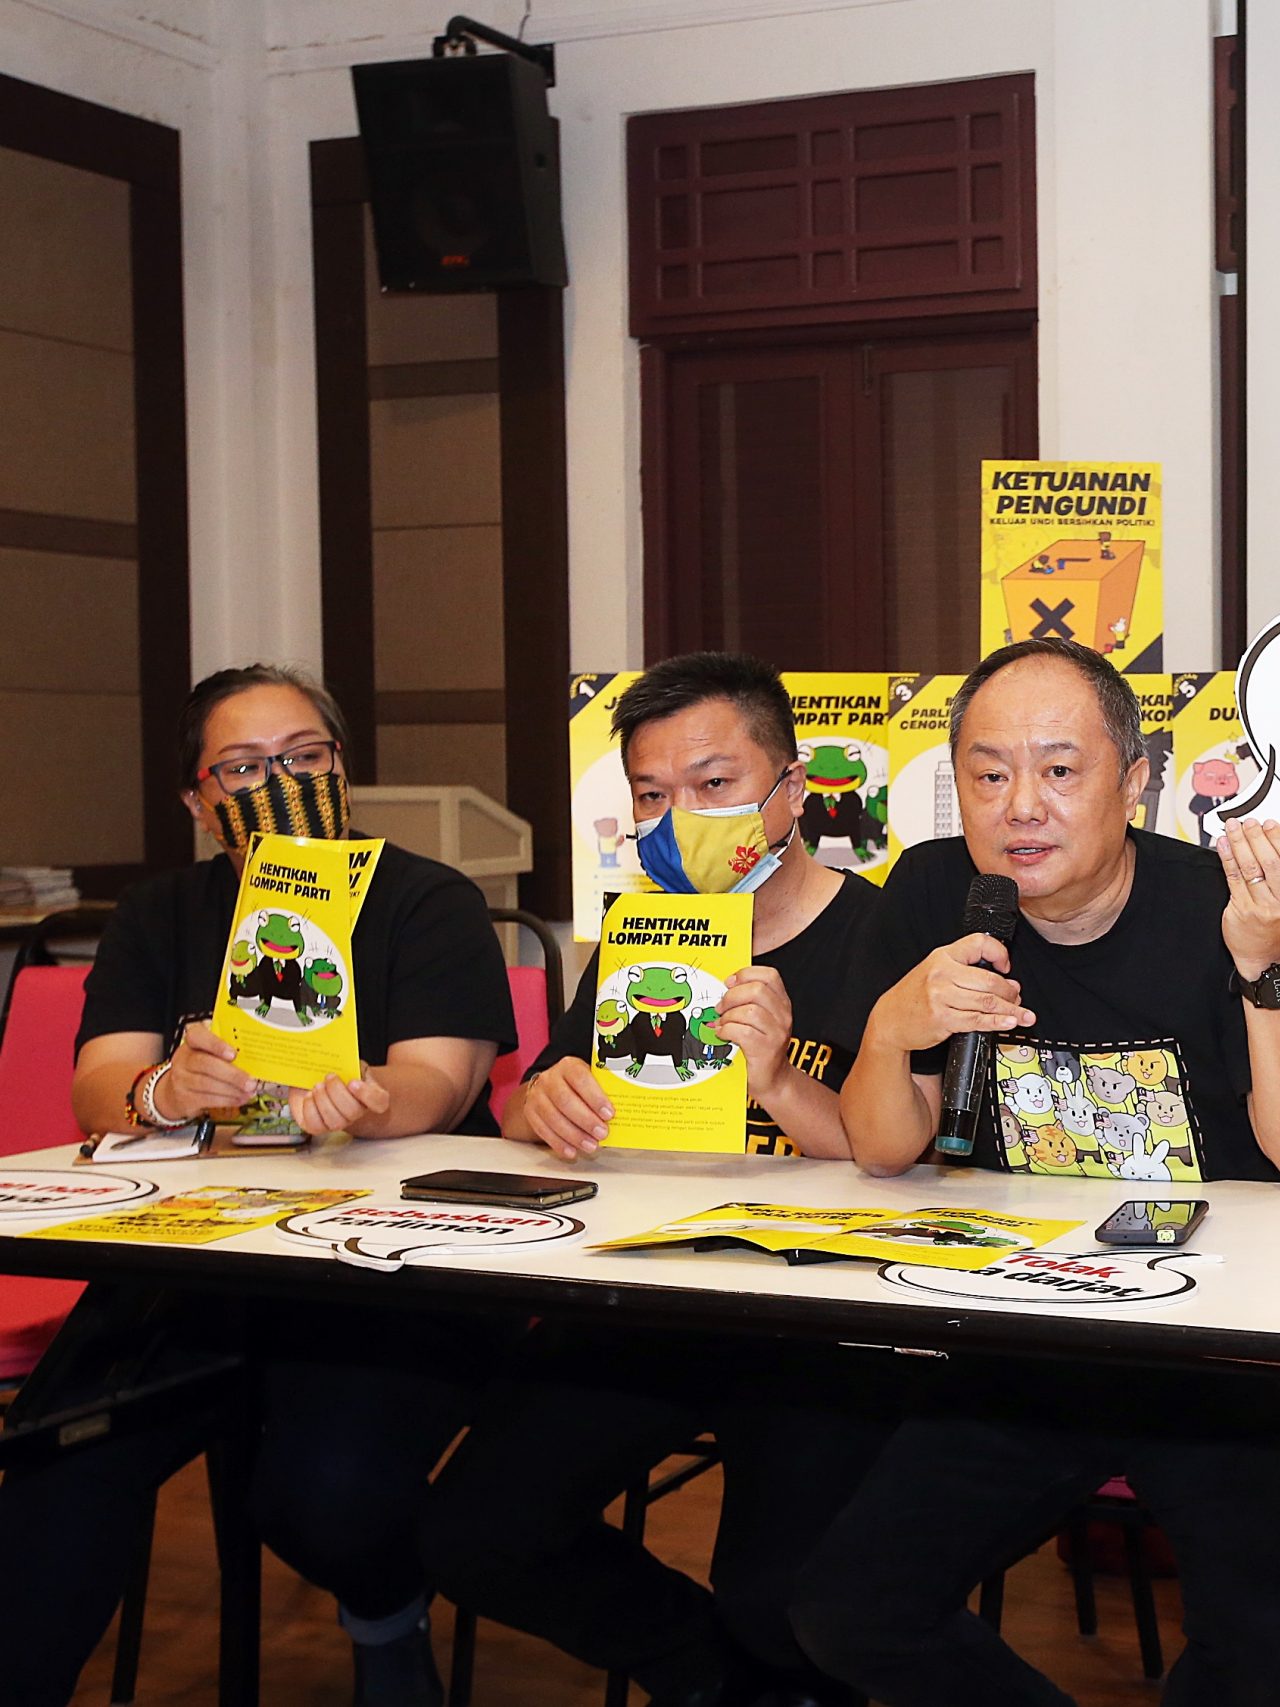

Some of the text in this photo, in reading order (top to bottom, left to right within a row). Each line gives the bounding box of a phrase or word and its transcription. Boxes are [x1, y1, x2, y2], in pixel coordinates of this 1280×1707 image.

[992, 471, 1151, 491] KETUANAN
[996, 495, 1146, 516] PENGUNDI
[989, 518, 1026, 526] KELUAR
[1030, 518, 1054, 526] UNDI
[579, 682, 595, 698] 1
[896, 684, 912, 701] 3
[1179, 680, 1196, 698] 5
[259, 861, 317, 884] HENTIKAN
[249, 874, 331, 901] LOMPAT PARTI
[622, 917, 710, 931] HENTIKAN
[608, 932, 728, 947] LOMPAT PARTI
[316, 1216, 514, 1236] Parlimen
[341, 1207, 551, 1227] Bebaskan
[1004, 1254, 1125, 1279] Tolak
[1003, 1271, 1144, 1297] darjat
